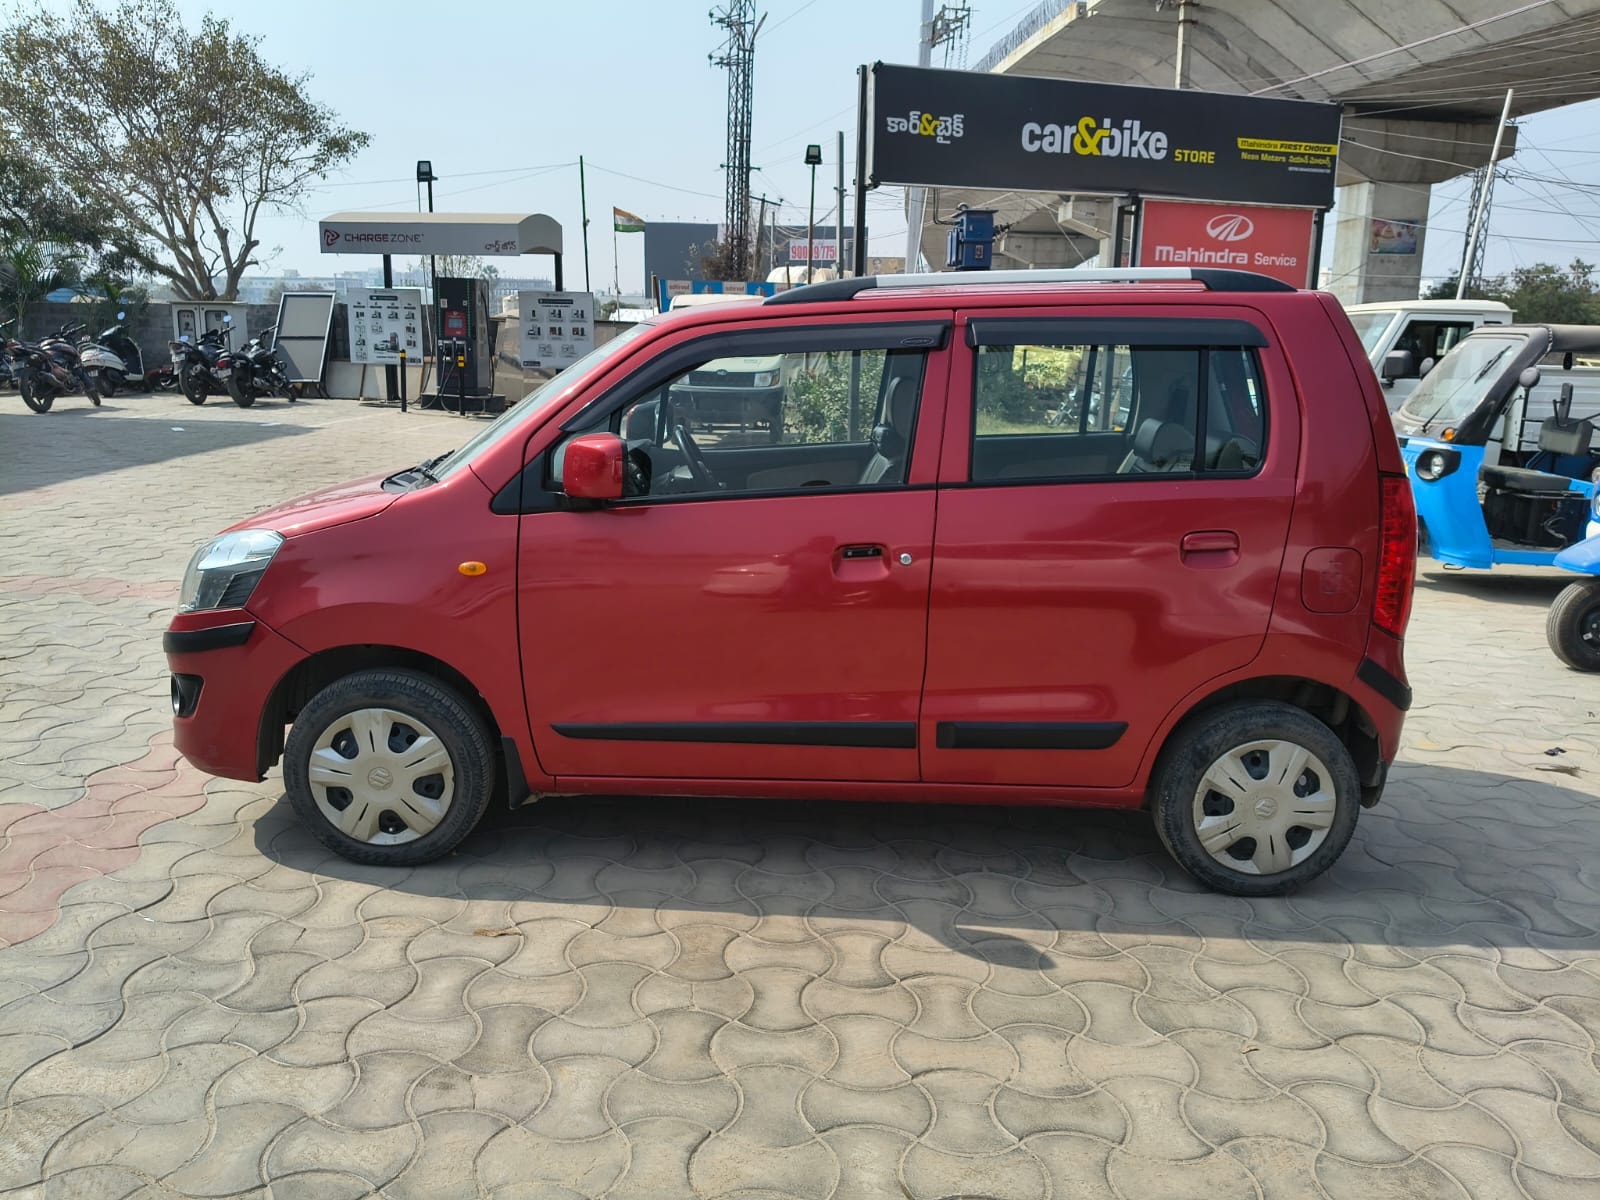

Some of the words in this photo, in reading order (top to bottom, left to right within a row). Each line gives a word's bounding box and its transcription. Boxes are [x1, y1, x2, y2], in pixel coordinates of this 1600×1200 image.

[1021, 116, 1168, 160] car&bike
[1174, 148, 1216, 164] STORE
[1240, 139, 1279, 150] Mahindra
[1279, 143, 1304, 152] FIRST
[1304, 145, 1332, 153] CHOICE
[1155, 245, 1249, 264] Mahindra
[1254, 252, 1297, 267] Service
